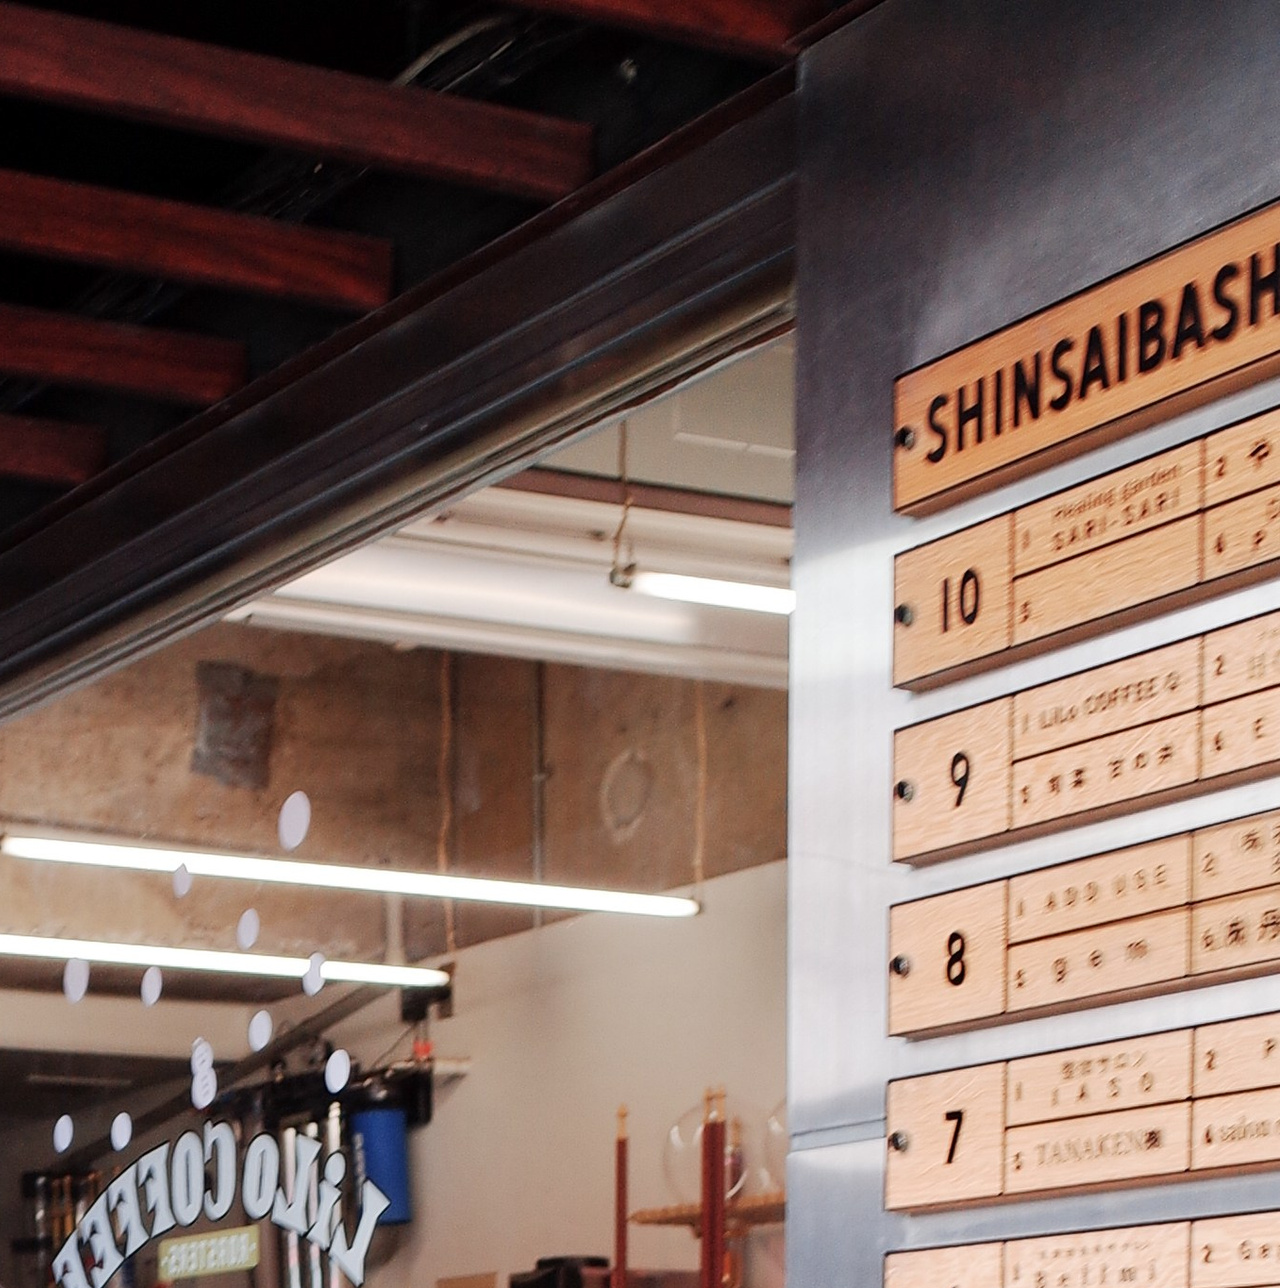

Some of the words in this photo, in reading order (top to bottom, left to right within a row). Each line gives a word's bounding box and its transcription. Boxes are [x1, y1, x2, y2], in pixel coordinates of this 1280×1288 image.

[941, 567, 981, 634] 10
[1081, 674, 1159, 716] COFFEE
[950, 750, 970, 808] 9
[1202, 851, 1216, 876] 2
[946, 931, 966, 986] 8
[944, 1108, 964, 1165] 7
